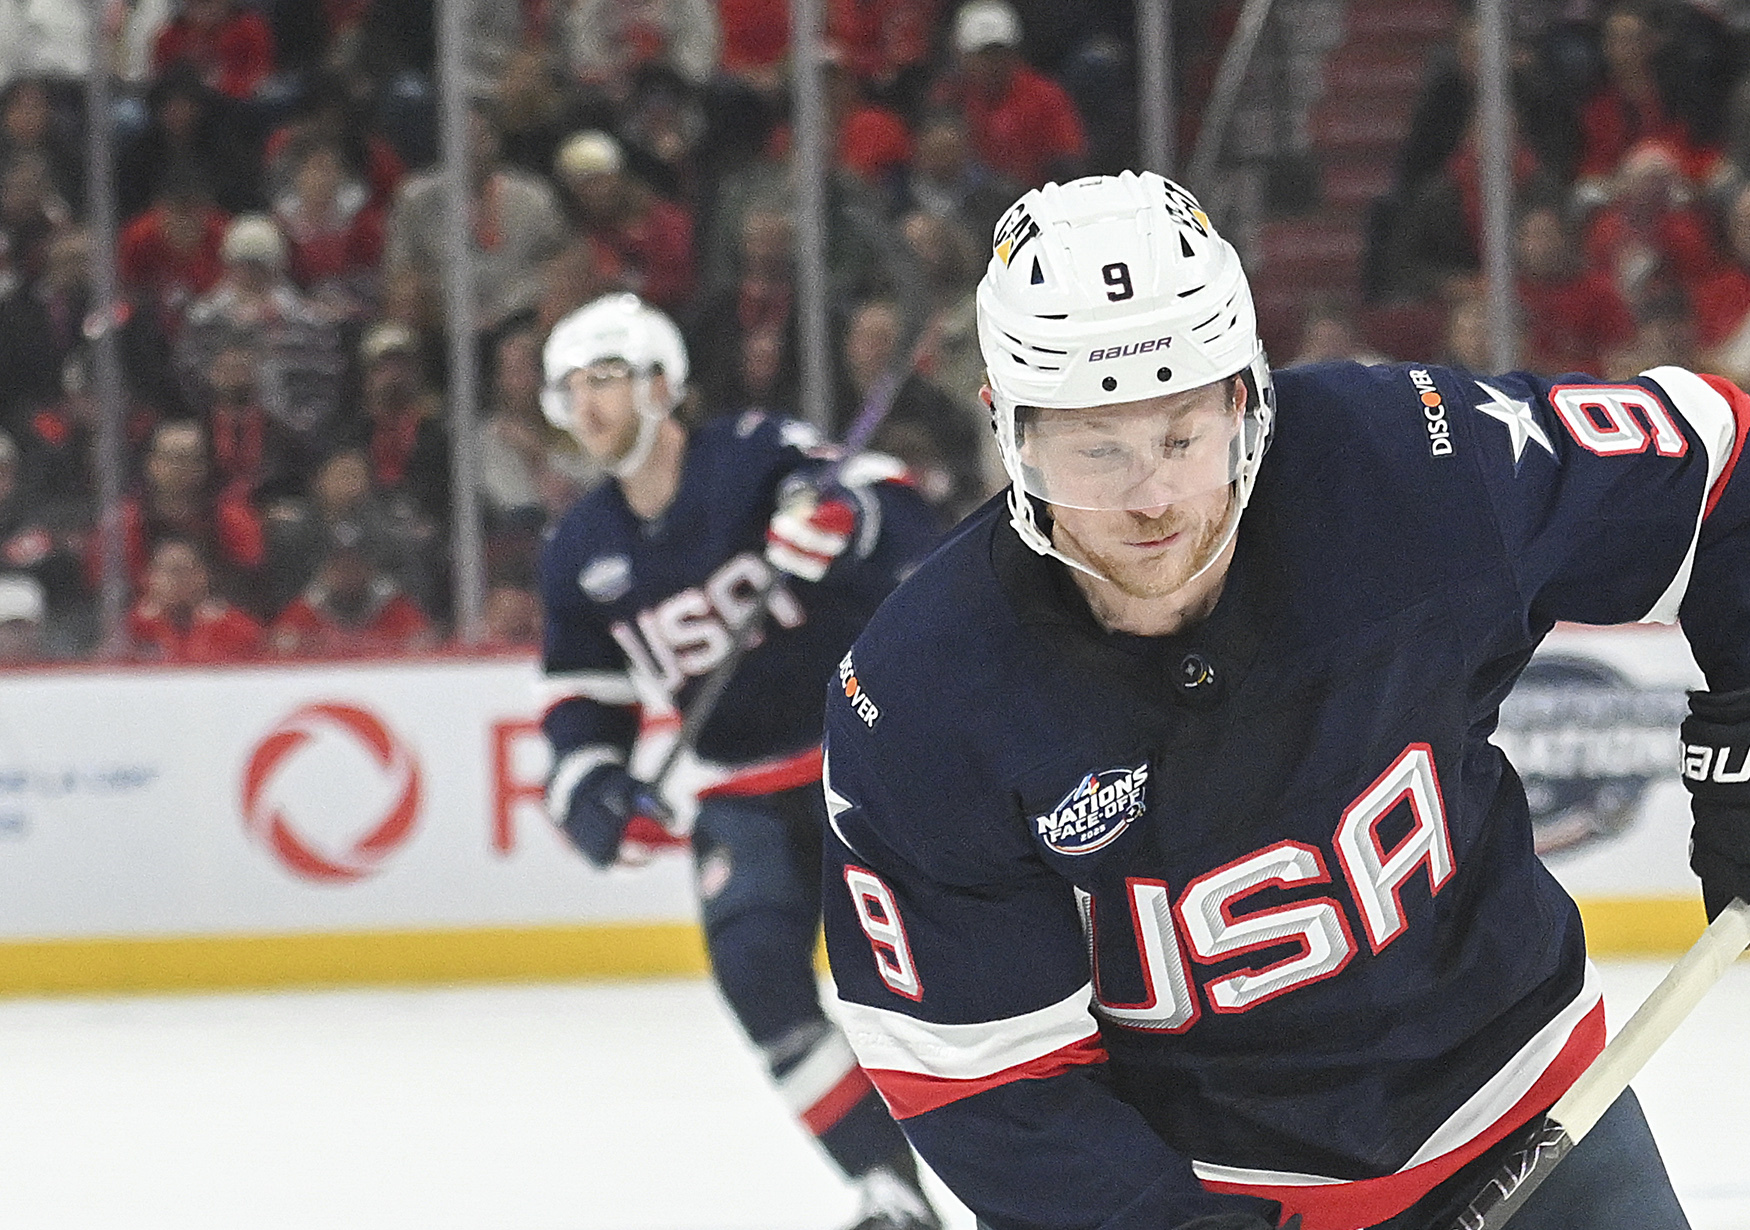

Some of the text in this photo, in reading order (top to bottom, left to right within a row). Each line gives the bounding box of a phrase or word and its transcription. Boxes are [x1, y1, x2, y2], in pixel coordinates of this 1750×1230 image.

[1101, 262, 1134, 302] 9
[1409, 368, 1453, 457] DISCOVER
[1549, 383, 1689, 457] 9
[610, 551, 808, 693] USA
[1036, 763, 1149, 835] NATIONS
[1049, 787, 1140, 844] FACE-OFF
[1073, 741, 1456, 1034] USA
[843, 864, 923, 1001] 9
